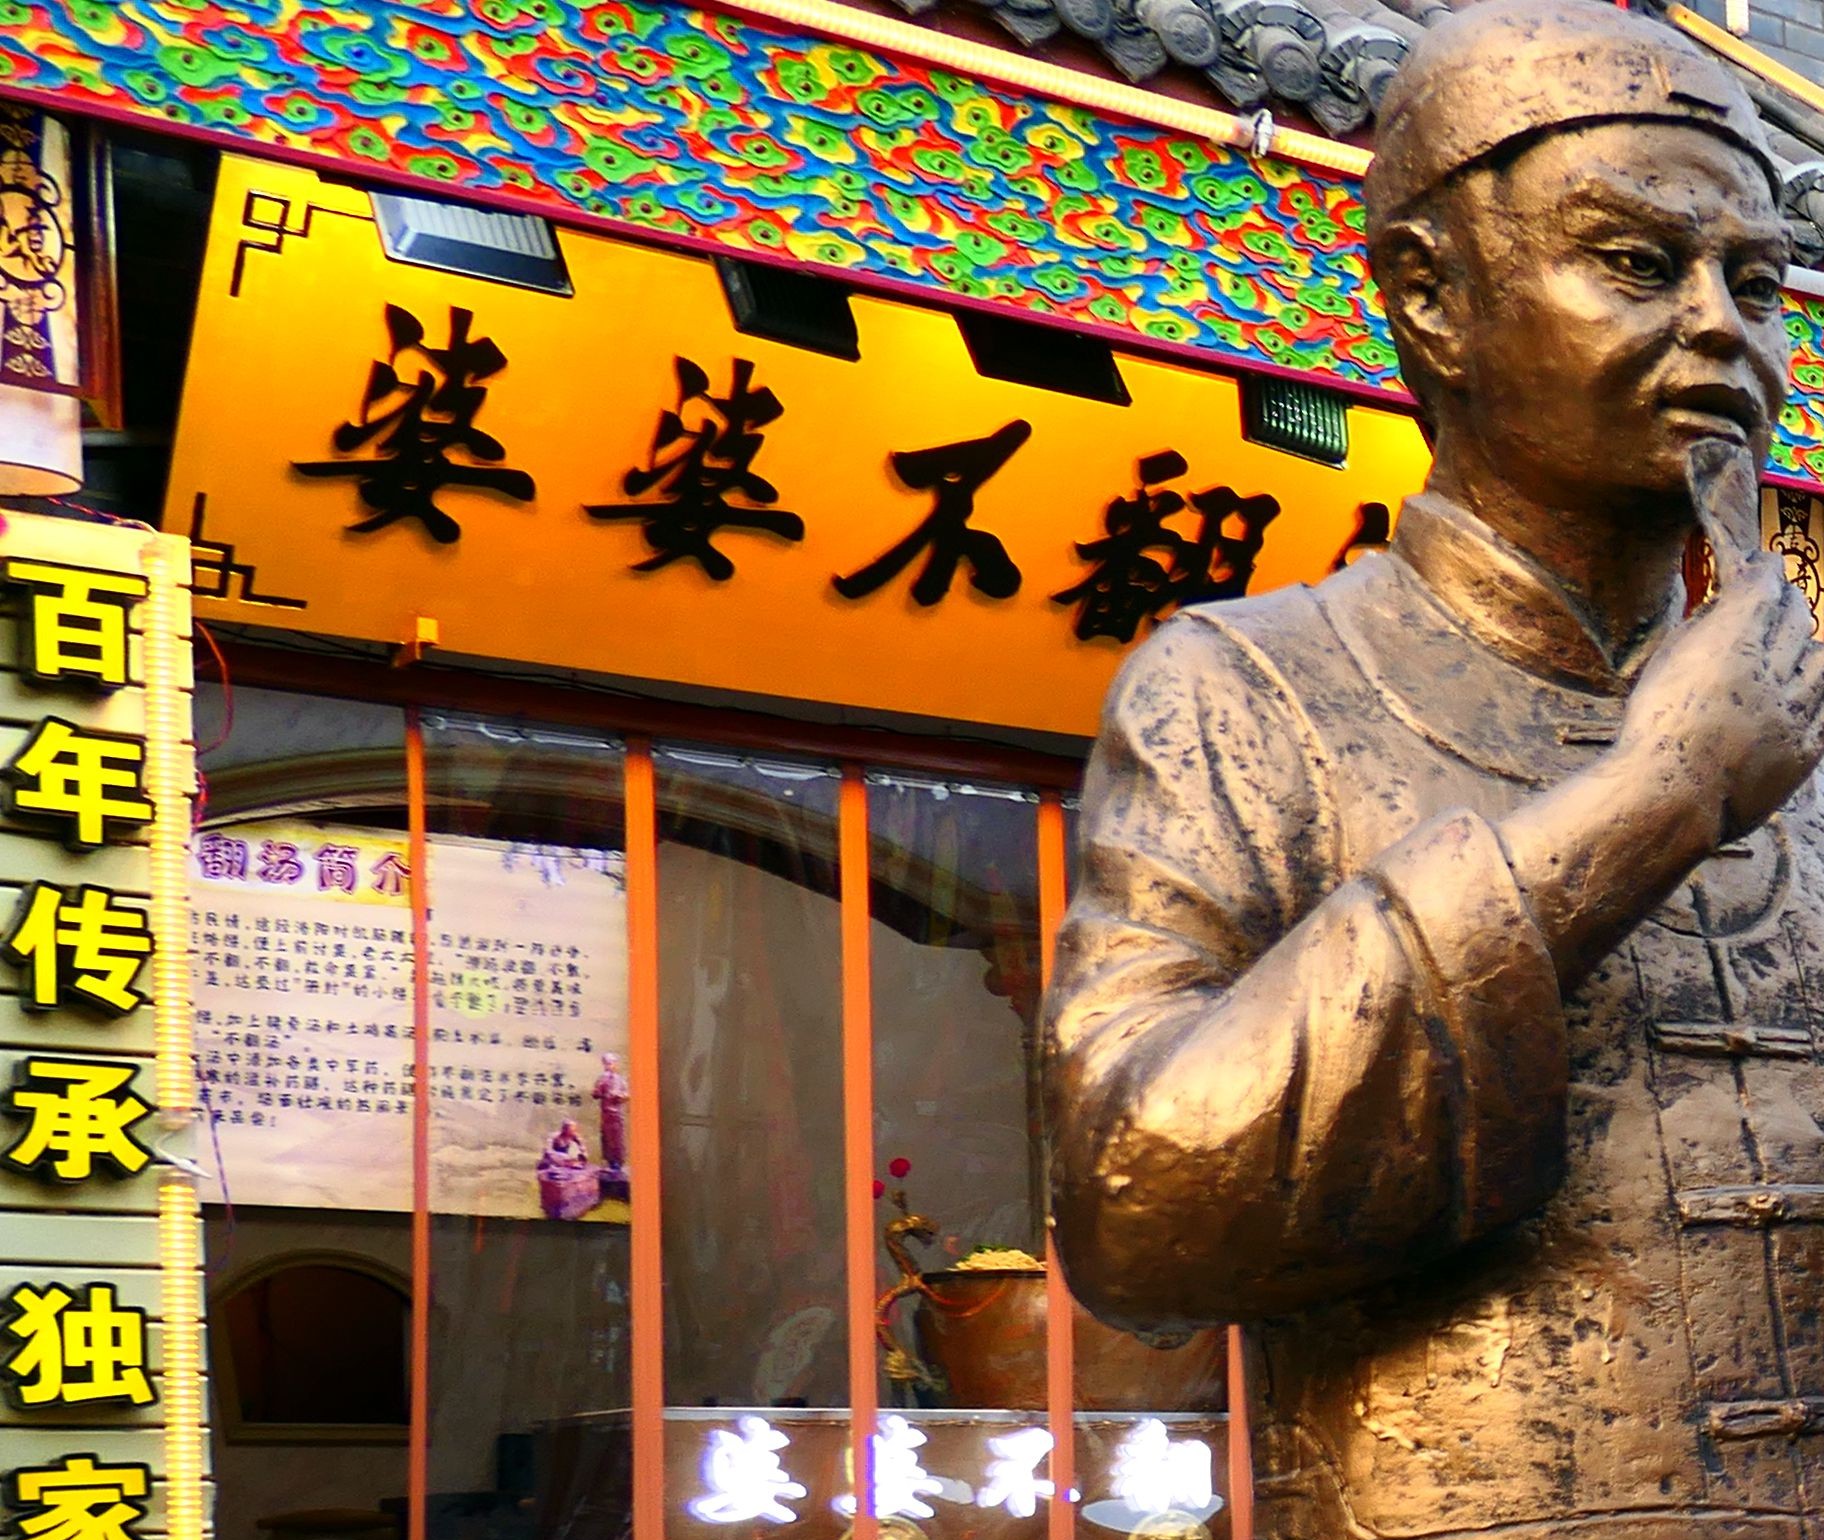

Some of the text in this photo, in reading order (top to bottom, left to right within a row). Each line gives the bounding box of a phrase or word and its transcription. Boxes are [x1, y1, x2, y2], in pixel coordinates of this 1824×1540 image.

[292, 303, 1392, 646] 婆婆不翻
[6, 560, 154, 1182] 百年传承
